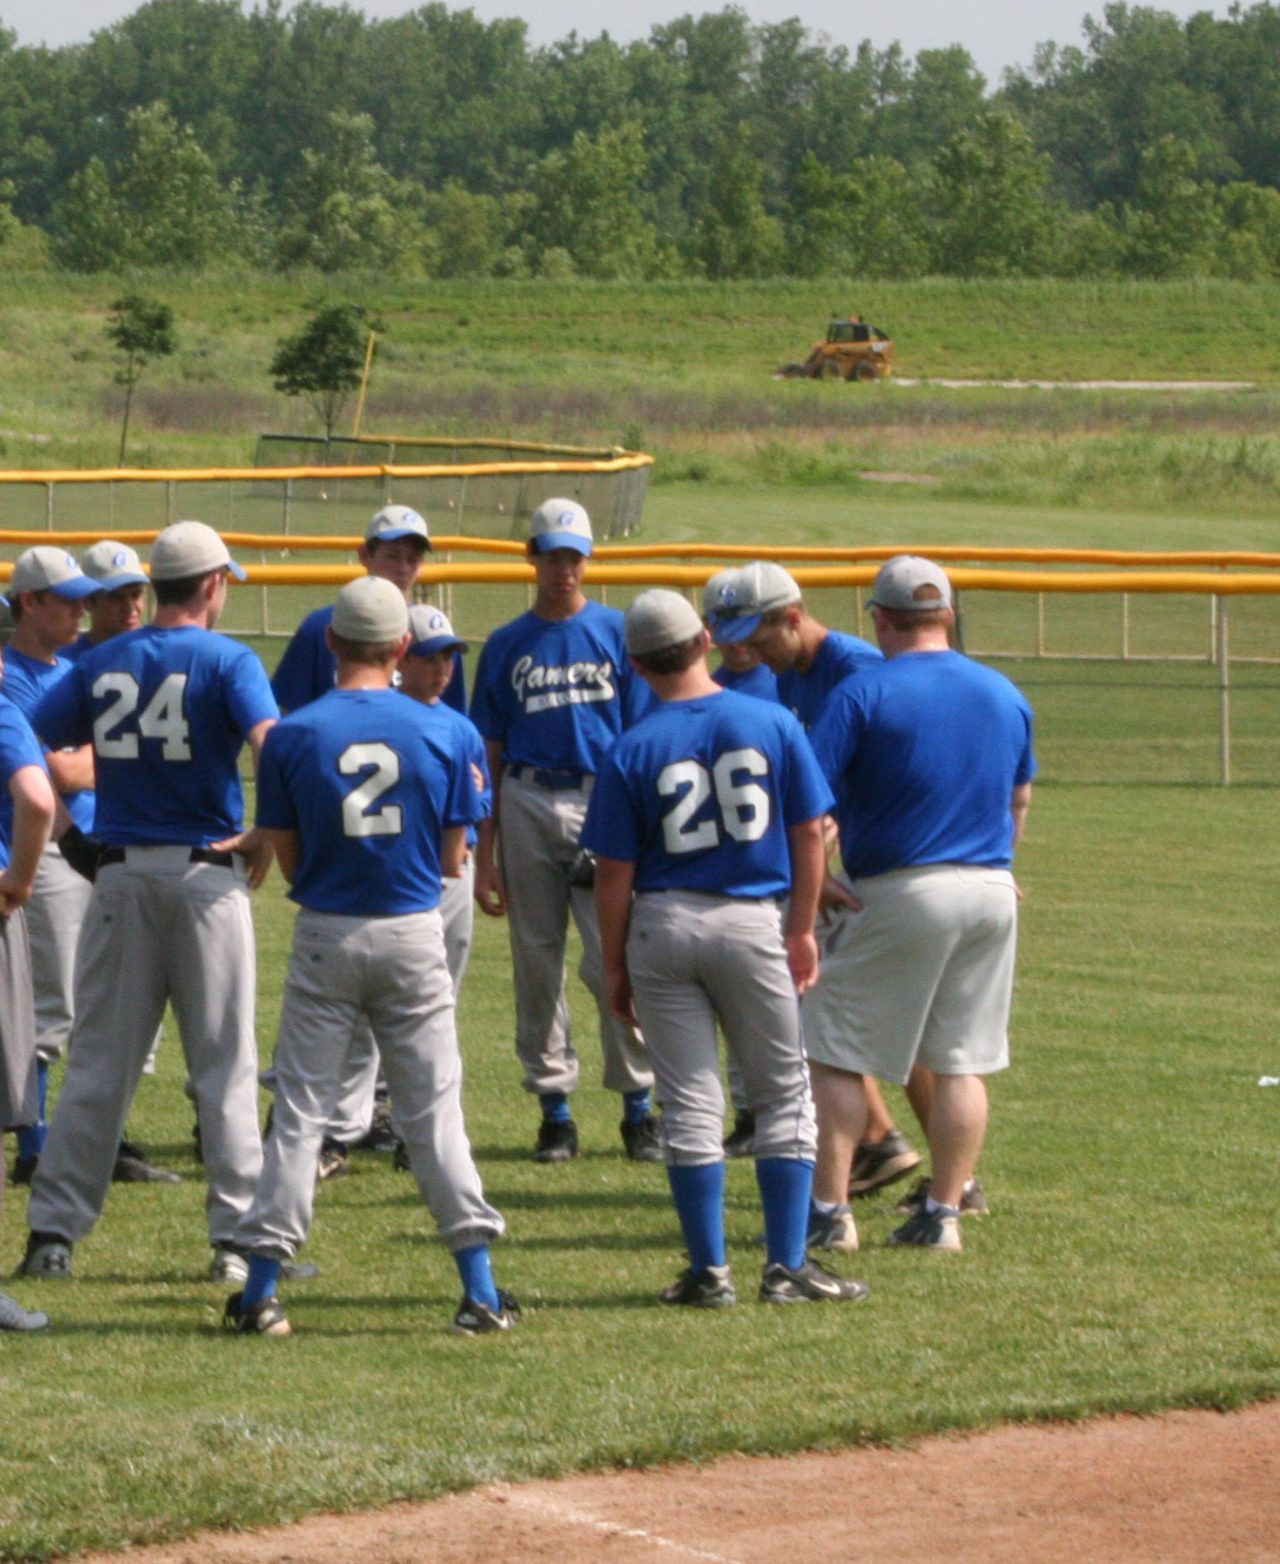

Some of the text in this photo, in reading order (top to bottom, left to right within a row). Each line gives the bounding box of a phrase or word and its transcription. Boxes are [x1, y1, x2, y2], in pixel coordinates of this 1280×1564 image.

[92, 671, 192, 761] 24
[512, 655, 615, 702] Gamers
[338, 742, 402, 838] 2
[656, 747, 769, 854] 26
